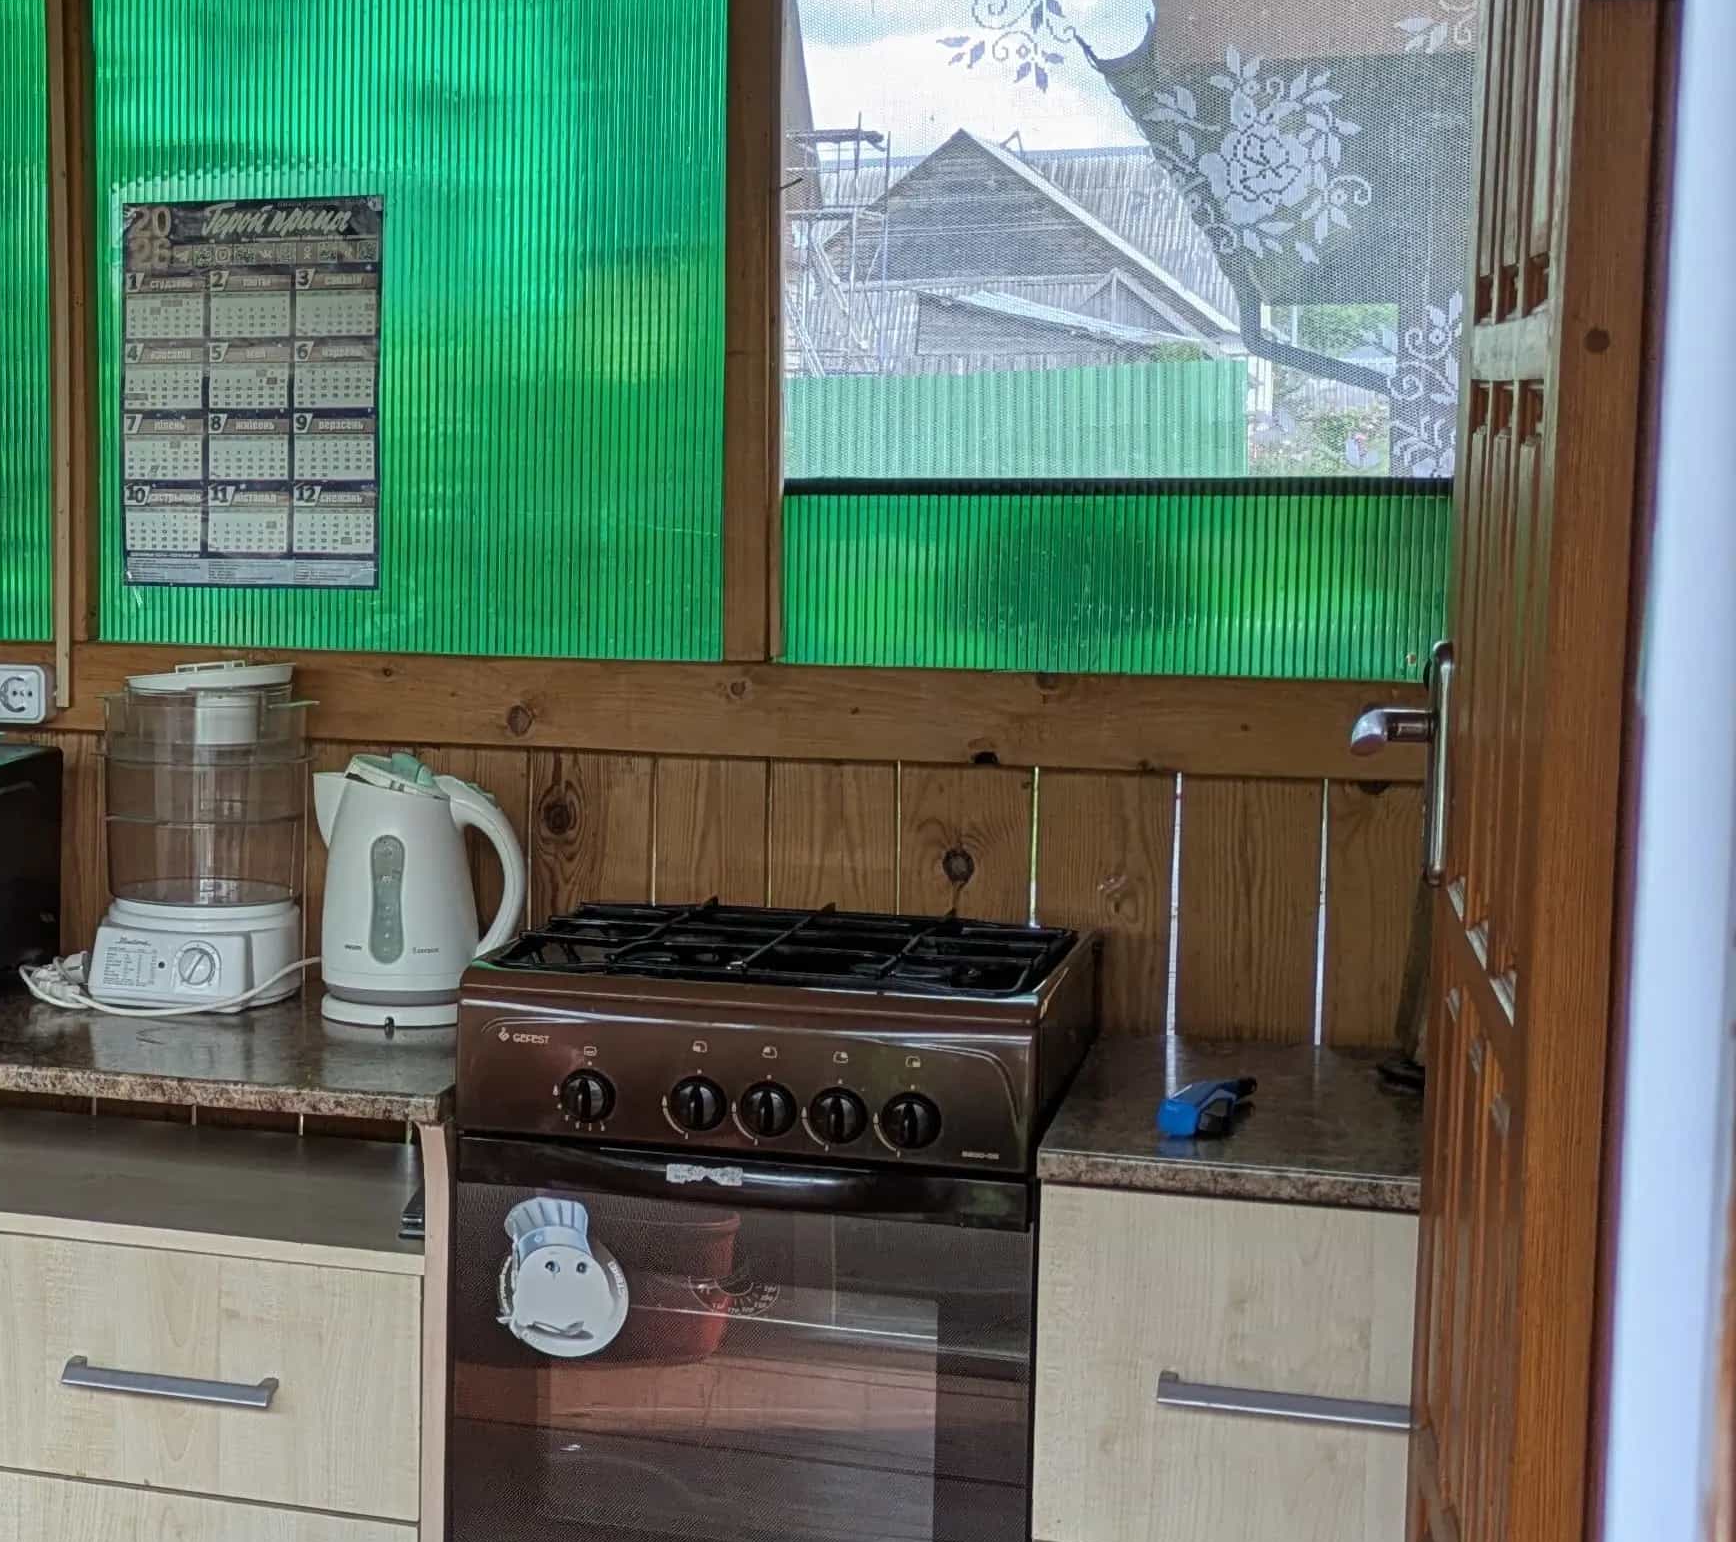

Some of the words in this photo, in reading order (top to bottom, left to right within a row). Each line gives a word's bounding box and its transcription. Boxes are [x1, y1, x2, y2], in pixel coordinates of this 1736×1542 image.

[133, 207, 171, 237] 20
[202, 203, 273, 238] Герой
[268, 208, 351, 237] працы
[127, 274, 137, 290] 1
[212, 271, 223, 288] 2
[296, 270, 309, 286] 3
[126, 345, 138, 360] 4
[210, 344, 221, 360] 5
[296, 344, 308, 359] 6
[126, 415, 136, 431] 7
[210, 415, 221, 430] 8
[295, 415, 307, 431] 9
[126, 484, 146, 503] 10
[210, 484, 229, 503] 11
[296, 484, 316, 503] 12
[512, 1032, 551, 1044] GEFEST
